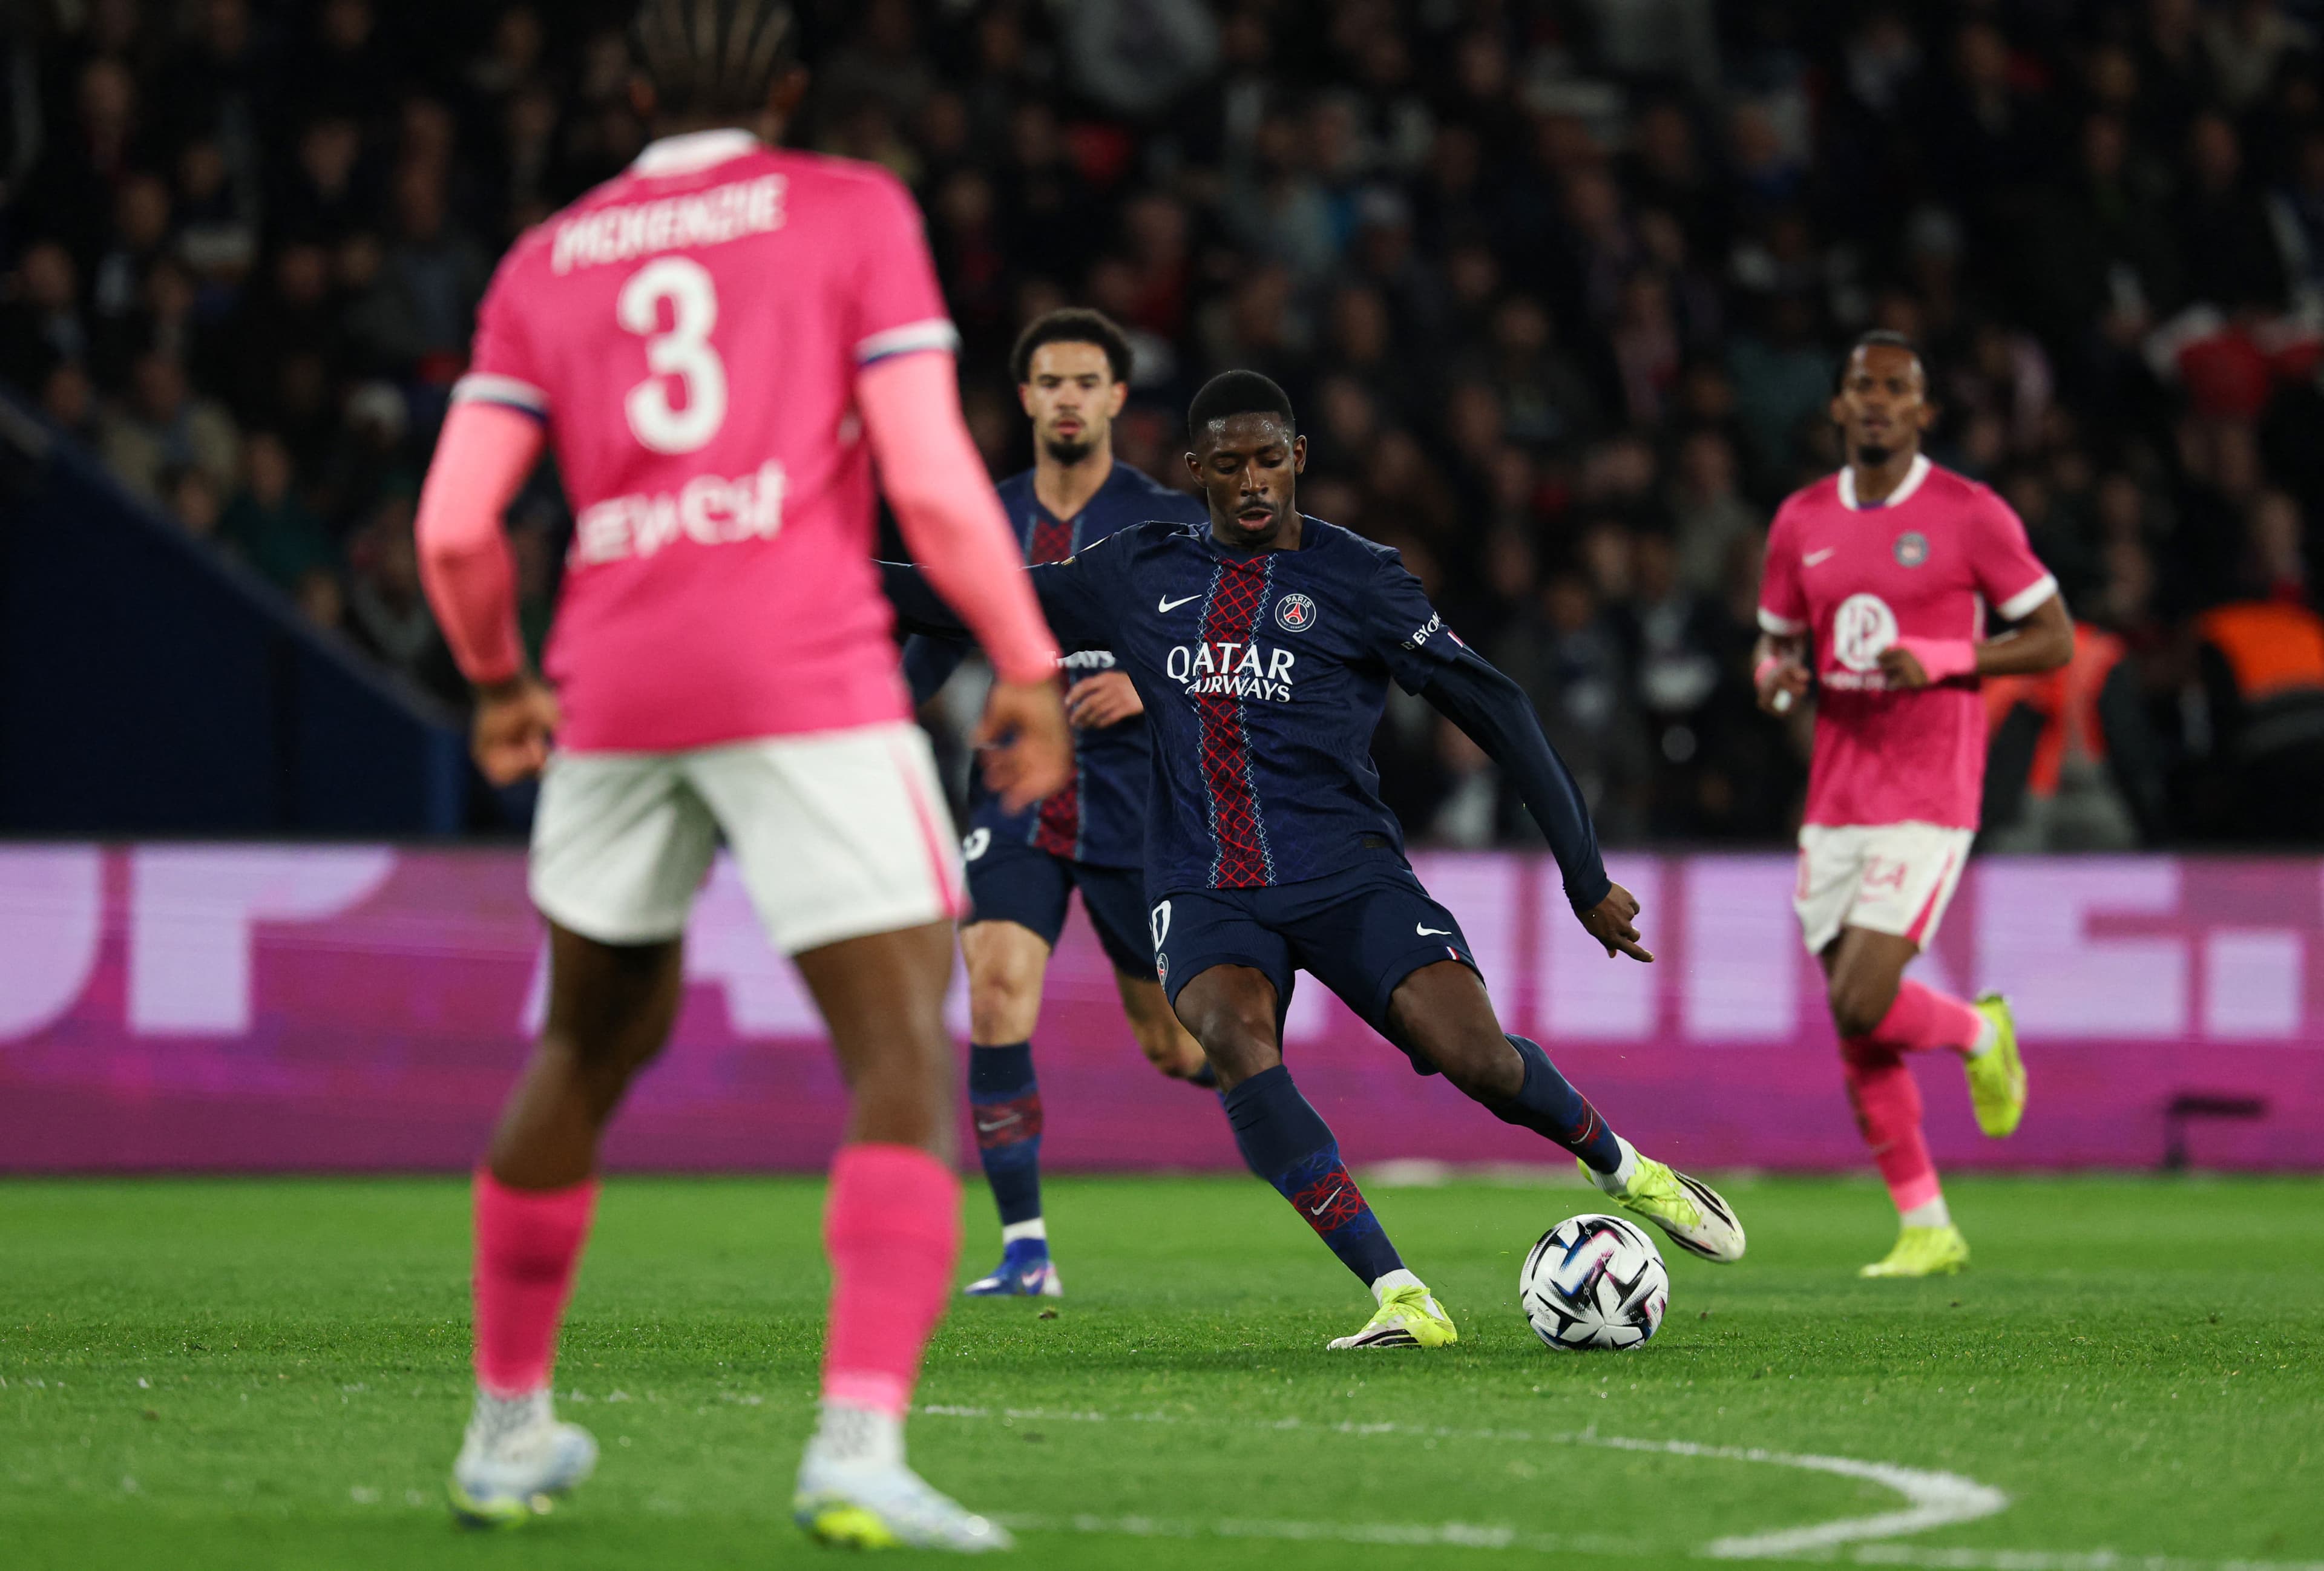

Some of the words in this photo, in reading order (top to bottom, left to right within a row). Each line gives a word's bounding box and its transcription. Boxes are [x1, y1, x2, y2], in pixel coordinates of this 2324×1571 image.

[617, 255, 725, 453] 3
[1285, 596, 1311, 608] PARIS
[1400, 611, 1441, 651] BEYON
[1167, 641, 1295, 686] QATAR
[1184, 674, 1291, 703] AIRWAYS
[1149, 900, 1172, 953] 0
